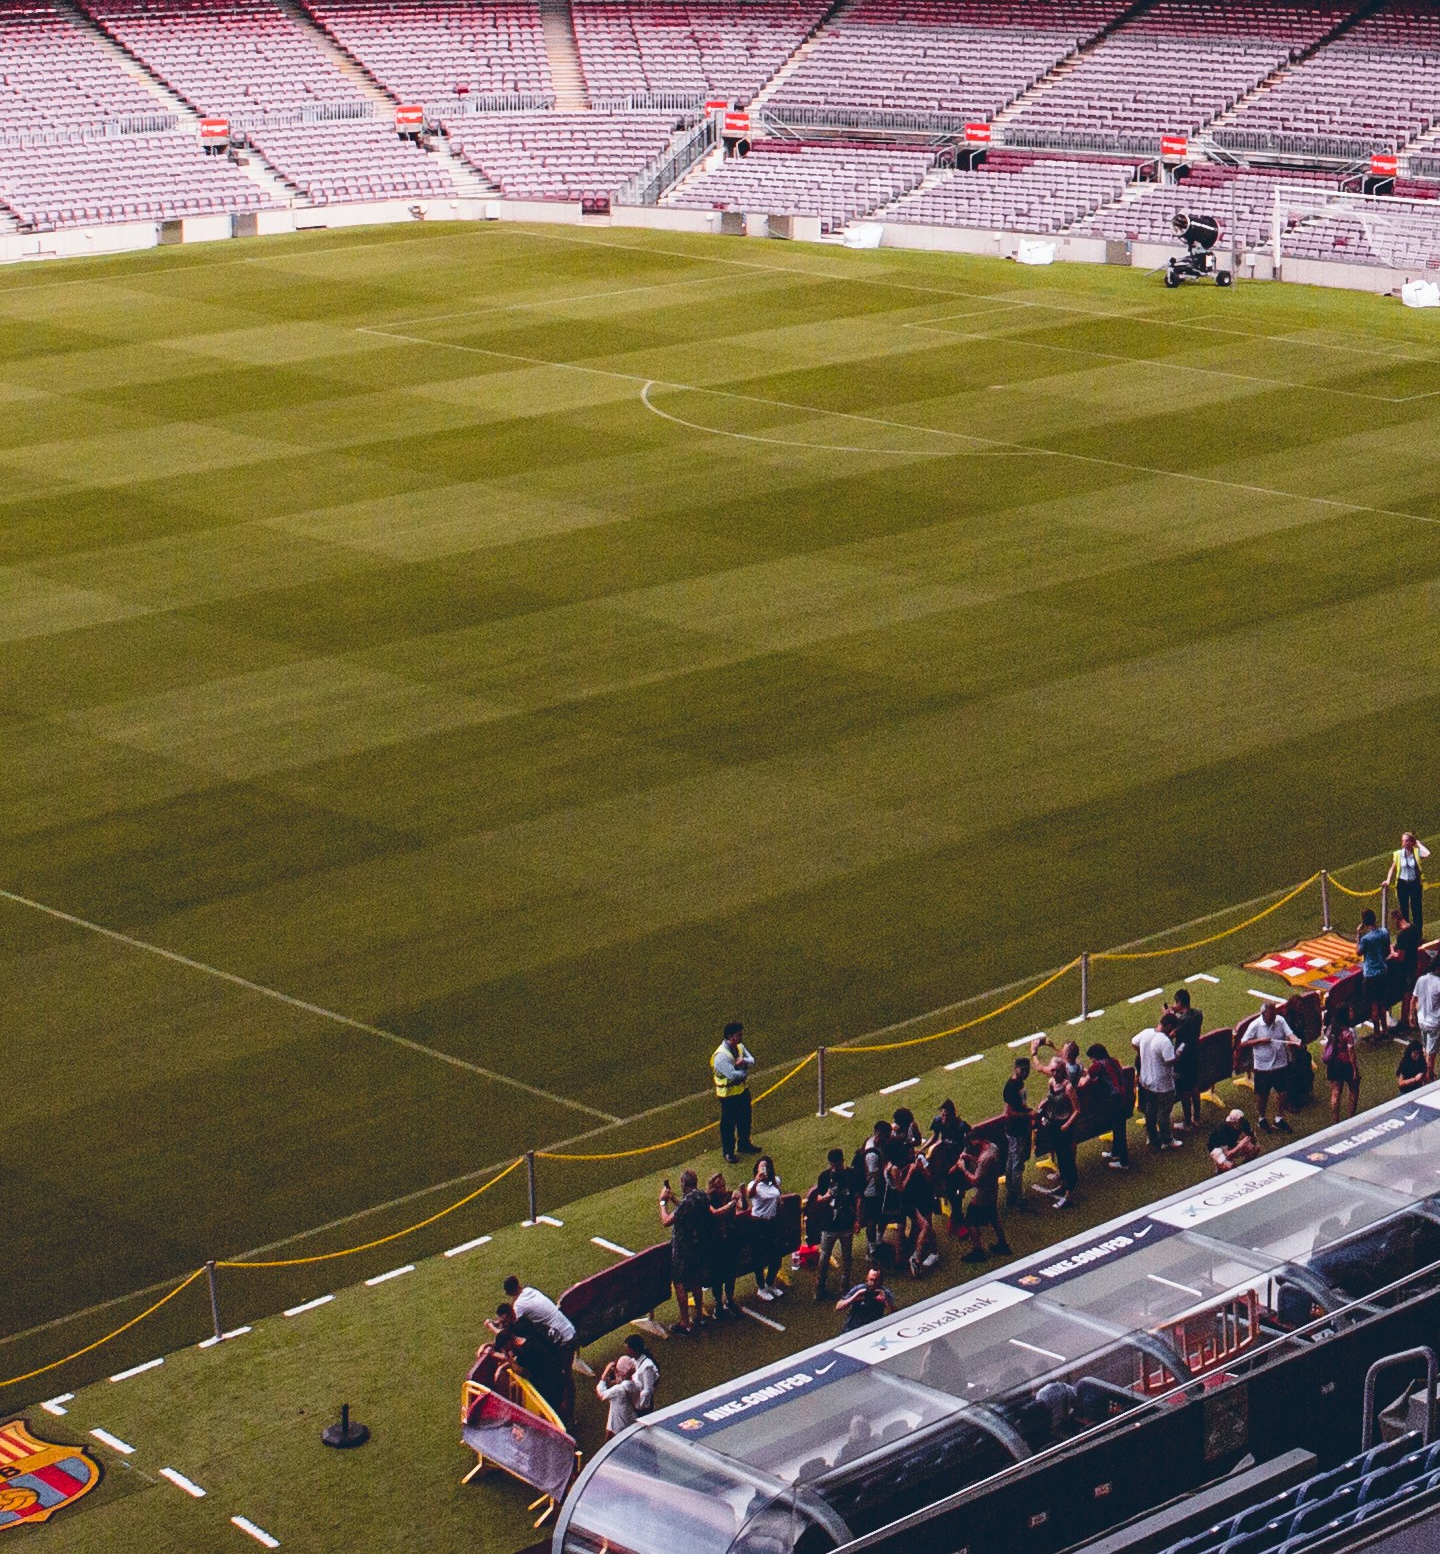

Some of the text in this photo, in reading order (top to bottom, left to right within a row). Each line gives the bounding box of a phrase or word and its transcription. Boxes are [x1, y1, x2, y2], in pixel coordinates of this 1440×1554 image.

[1202, 1170, 1289, 1208] CaixaBank
[896, 1294, 997, 1341] CaixaBank
[702, 1372, 813, 1423] NIKE.COM/FCB
